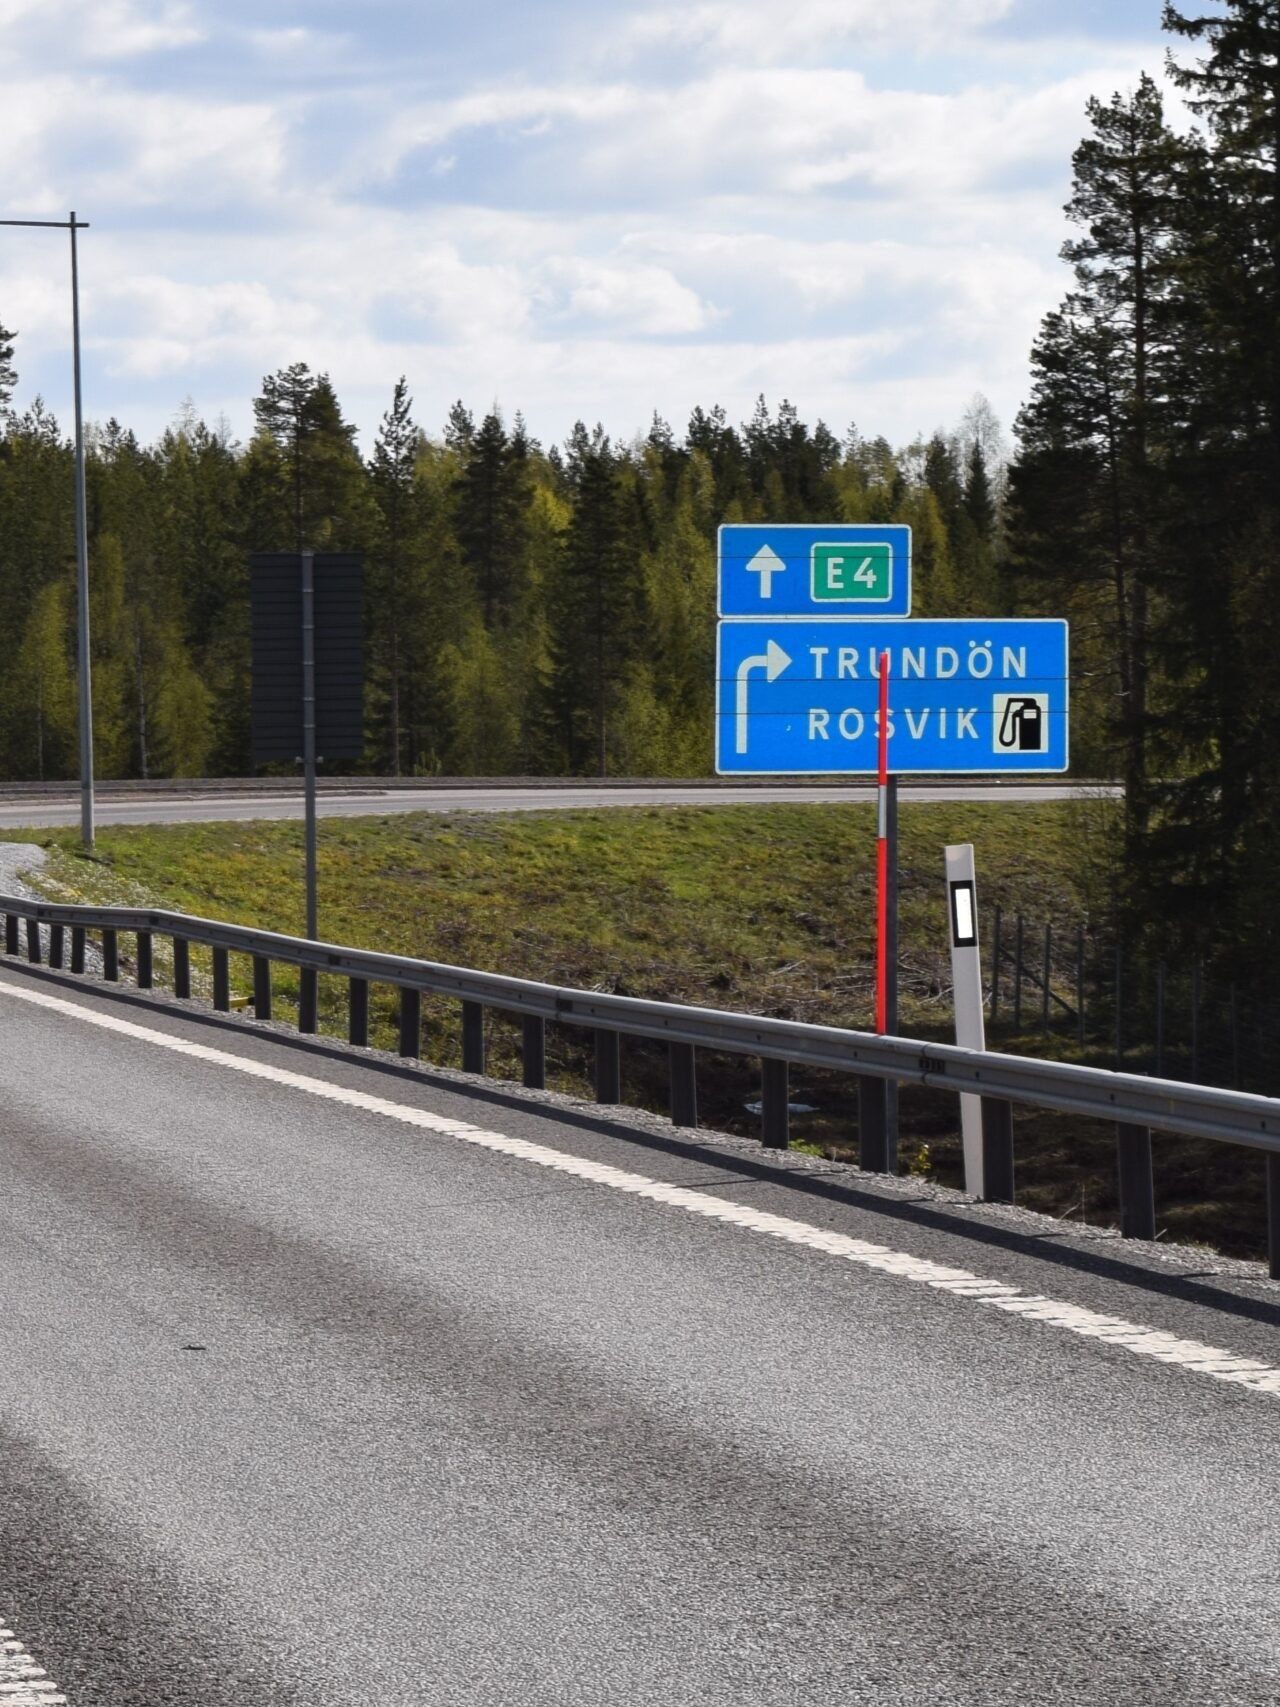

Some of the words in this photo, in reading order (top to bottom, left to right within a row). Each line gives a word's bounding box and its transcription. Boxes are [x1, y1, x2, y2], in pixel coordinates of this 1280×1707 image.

[827, 557, 844, 589] E
[853, 557, 877, 589] 4
[809, 640, 1027, 679] TRUNDÖN
[808, 707, 979, 740] ROSVIK
